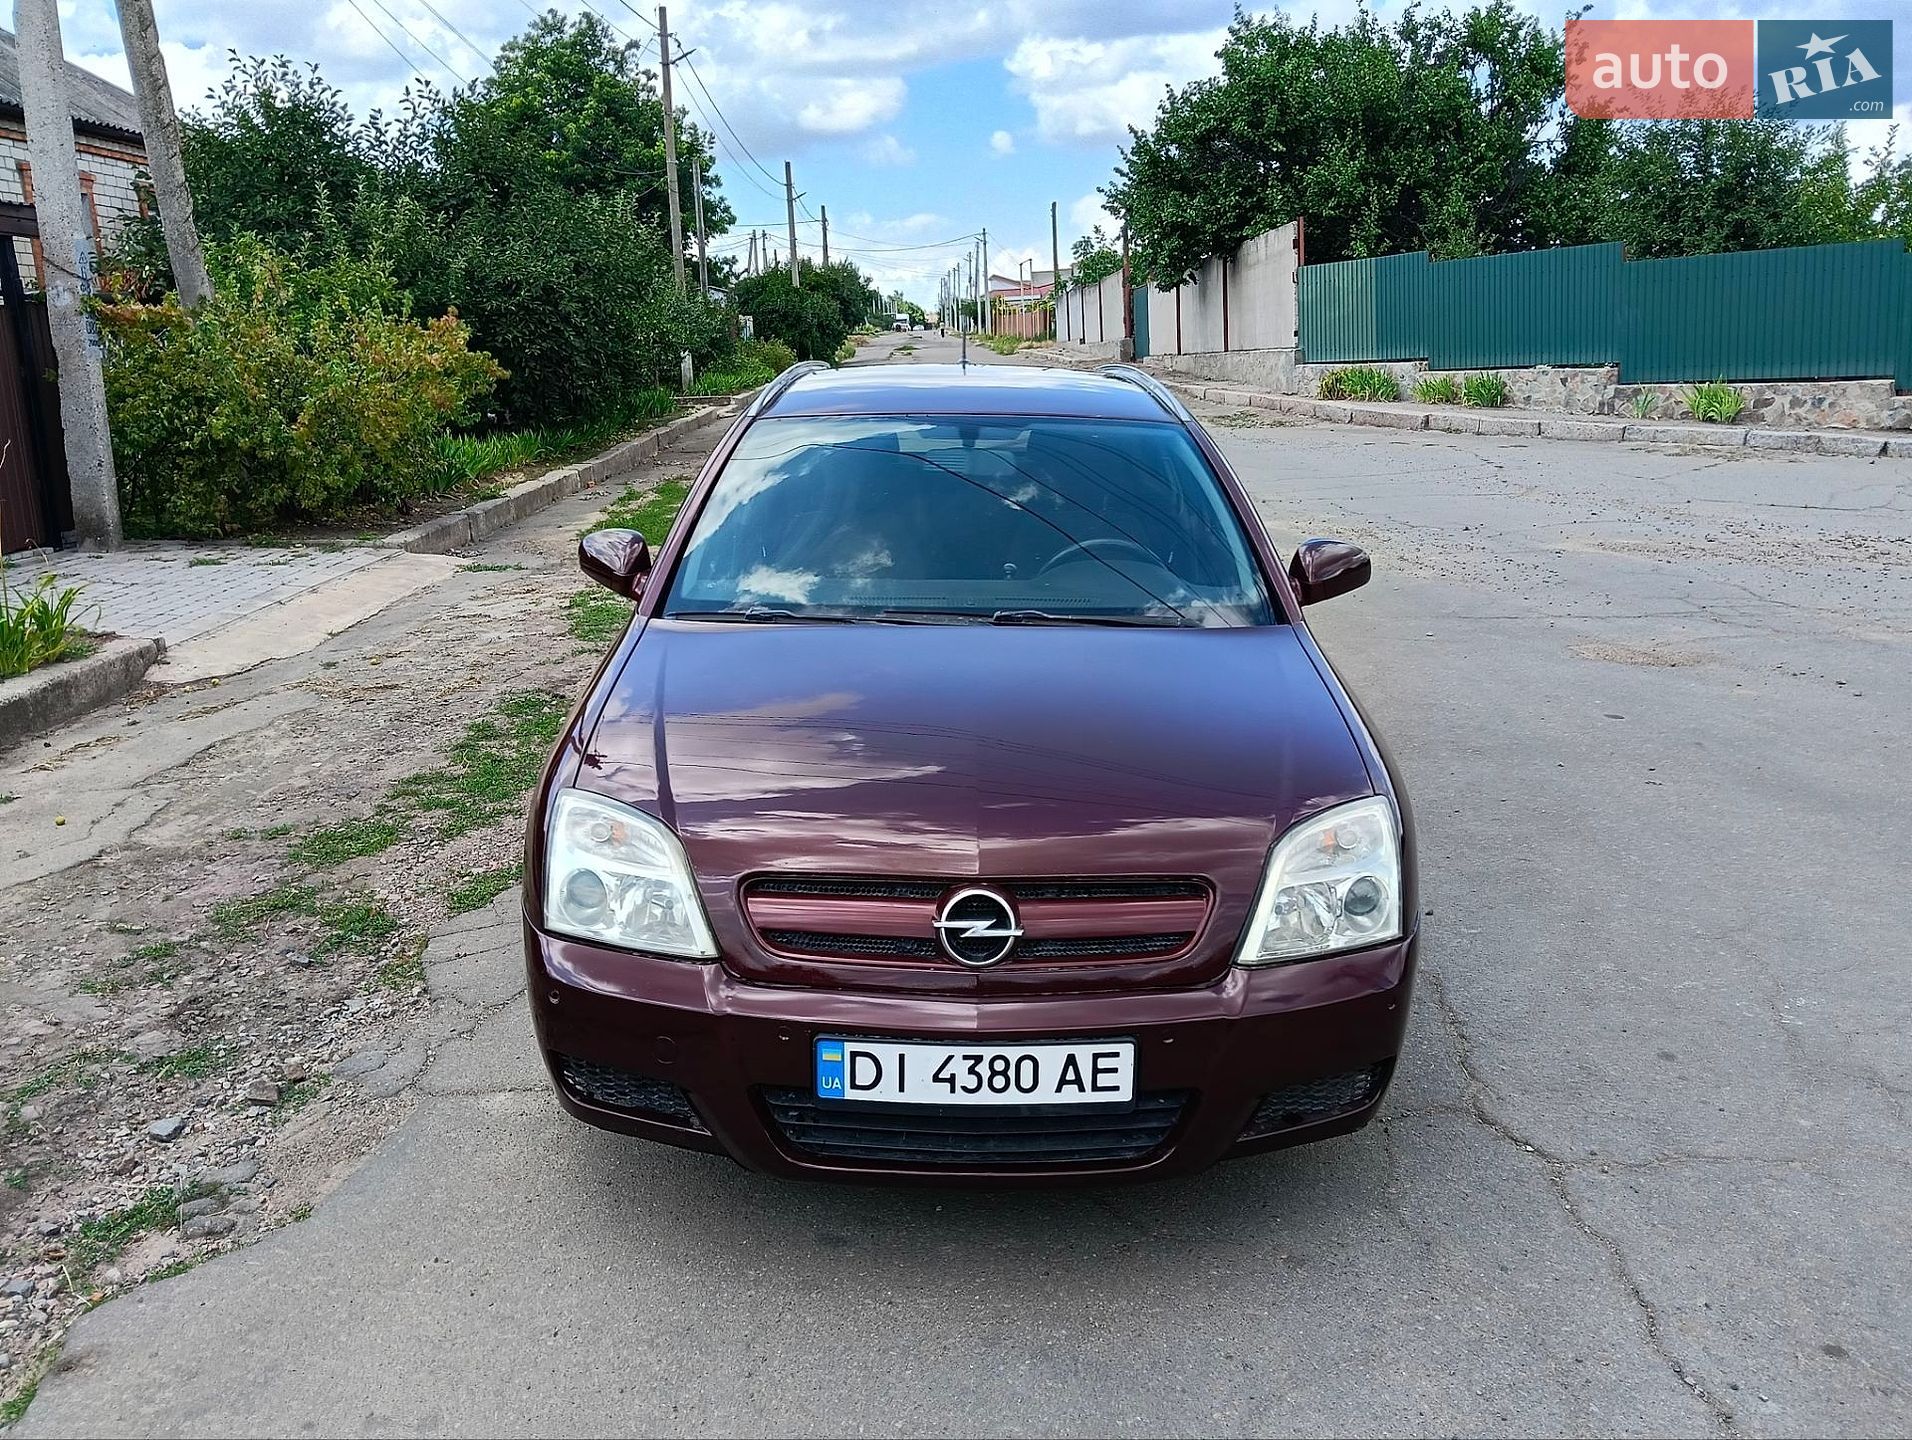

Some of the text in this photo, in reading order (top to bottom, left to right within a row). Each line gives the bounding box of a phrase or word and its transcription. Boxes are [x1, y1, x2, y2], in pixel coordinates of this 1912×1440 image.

[821, 1077, 842, 1089] UA
[932, 1054, 1040, 1094] 4380
[1055, 1052, 1121, 1093] AE
